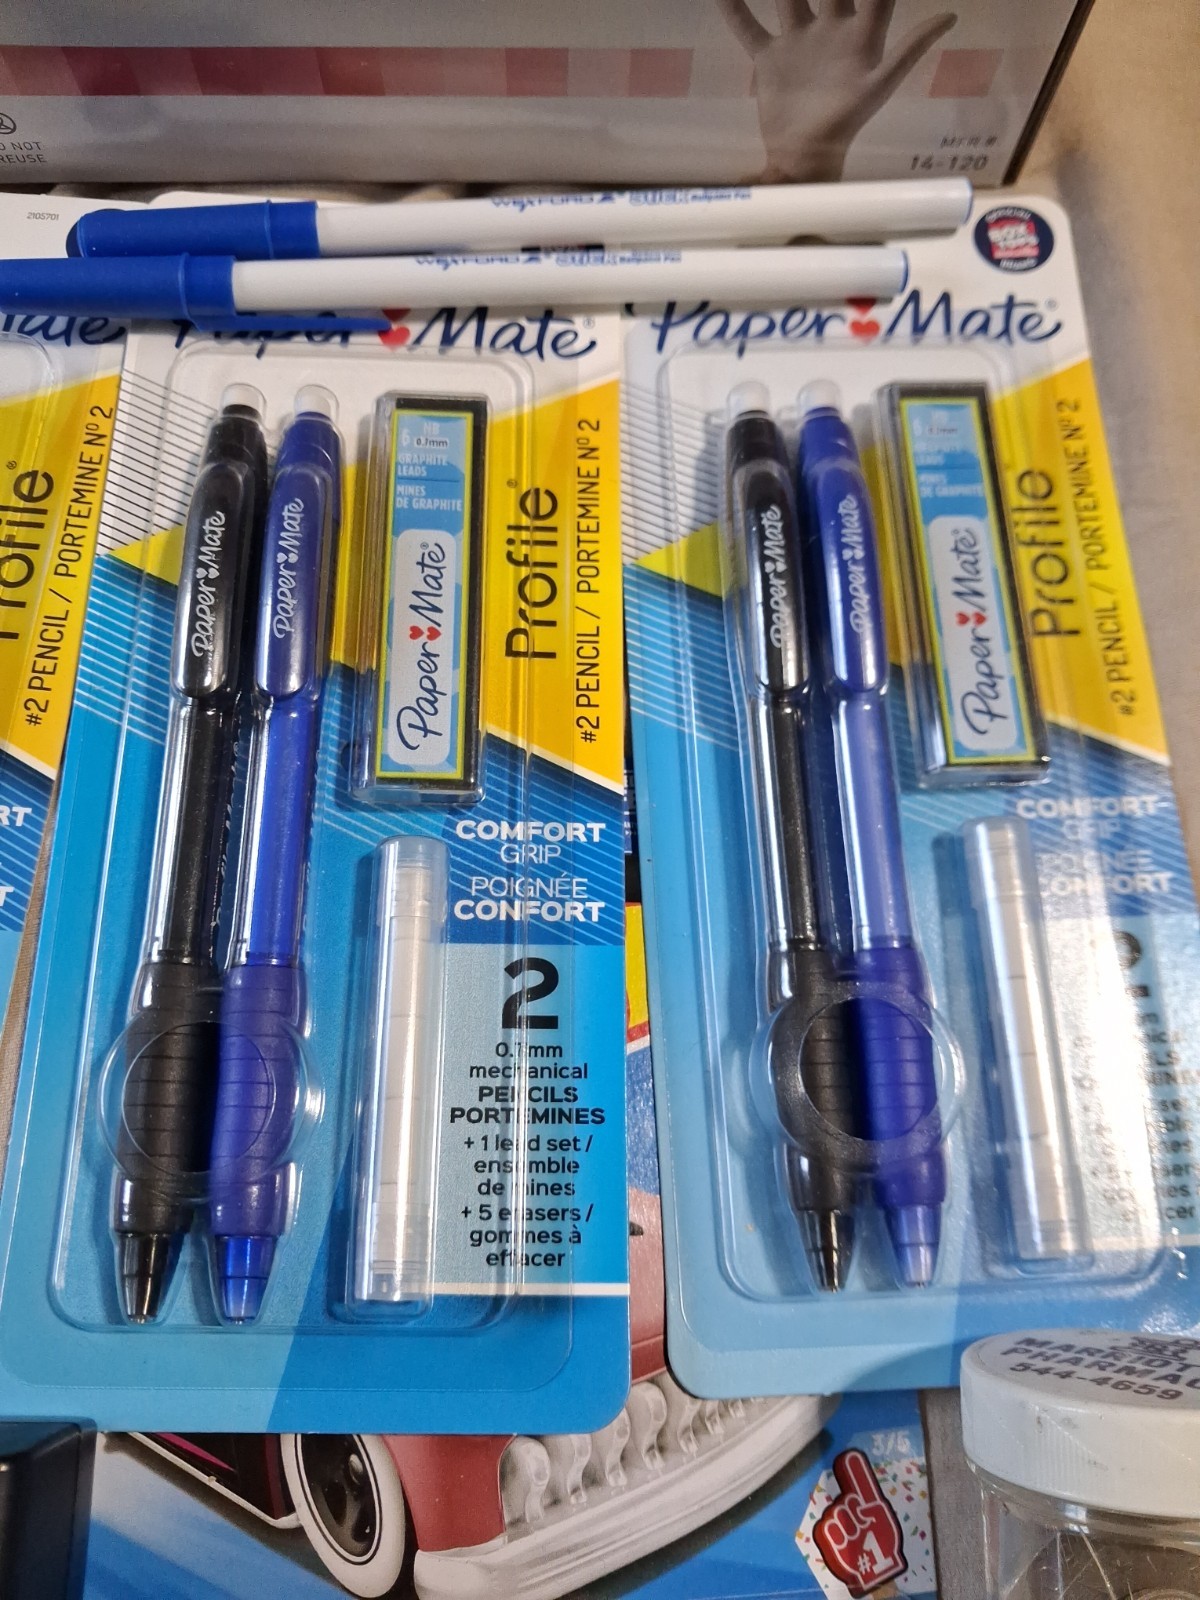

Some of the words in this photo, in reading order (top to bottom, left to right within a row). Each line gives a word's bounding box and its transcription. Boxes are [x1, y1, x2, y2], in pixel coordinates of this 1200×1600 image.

[0, 154, 47, 164] REUSE
[11, 141, 42, 151] NOT
[27, 212, 60, 221] 2105701
[408, 306, 597, 361] Mate
[884, 289, 1062, 346] Mate
[90, 405, 113, 419] 2
[577, 418, 600, 432] 2
[398, 453, 449, 465] GRAPHITE
[415, 437, 448, 447] 0.7mm
[397, 465, 428, 477] LEADS
[397, 484, 427, 497] MINES
[53, 451, 104, 578] PORTEMINE
[278, 497, 305, 554] Mate
[395, 498, 409, 509] DE
[412, 498, 463, 512] GRAPHITE
[1063, 444, 1112, 572] PORTEMINE
[198, 510, 226, 568] Mate
[576, 466, 600, 593] PORTEMINE
[761, 504, 786, 563] Mate
[504, 486, 559, 659] Profile
[950, 527, 987, 612] Mate
[1011, 469, 1081, 639] Profile
[273, 564, 299, 639] Paper
[408, 542, 447, 628] Mate
[191, 579, 217, 657] Paper
[770, 572, 791, 648] Paper
[27, 609, 70, 691] PENCIL
[1094, 600, 1132, 683] PENCIL
[575, 625, 601, 709] PENCIL
[961, 628, 1009, 735] Paper
[24, 697, 50, 727] #2
[396, 642, 448, 751] Paper
[575, 714, 601, 744] #2
[455, 819, 606, 842] COMFORT
[500, 843, 562, 864] GRIP
[471, 872, 588, 899] POIGNÉE
[1040, 871, 1174, 896] ONORT
[454, 899, 606, 922] CONFORT
[501, 957, 560, 1030] 2
[546, 1136, 581, 1152] set
[477, 1178, 506, 1196] de
[479, 1203, 493, 1221] 5
[569, 1224, 582, 1244] à
[1010, 1362, 1184, 1400] 544-4659
[857, 1530, 895, 1577] #1
